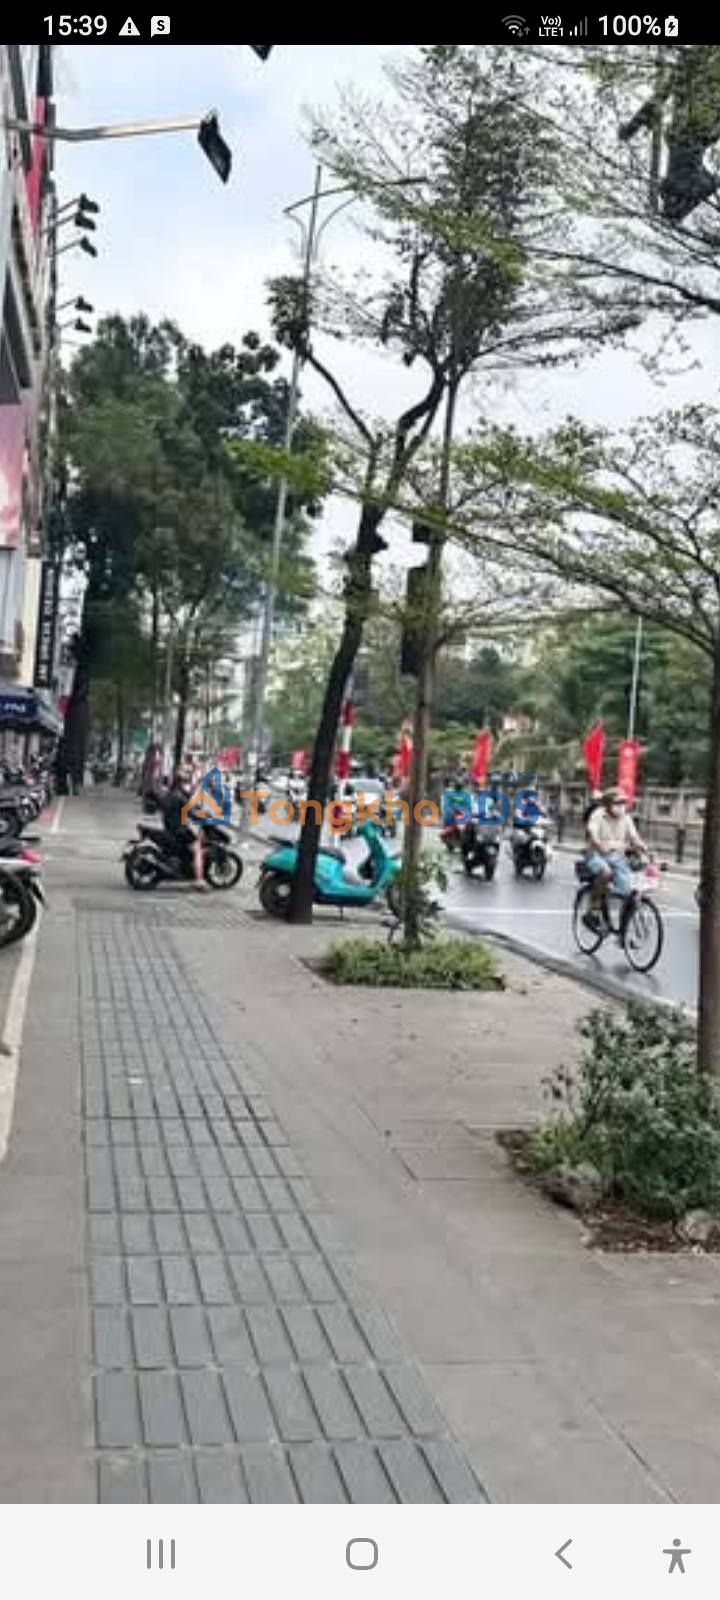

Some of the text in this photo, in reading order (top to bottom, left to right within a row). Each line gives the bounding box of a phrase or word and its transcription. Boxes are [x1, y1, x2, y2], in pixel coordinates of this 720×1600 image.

[43, 14, 108, 36] 15:39
[538, 27, 564, 37] LTE1
[598, 14, 662, 36] 100%
